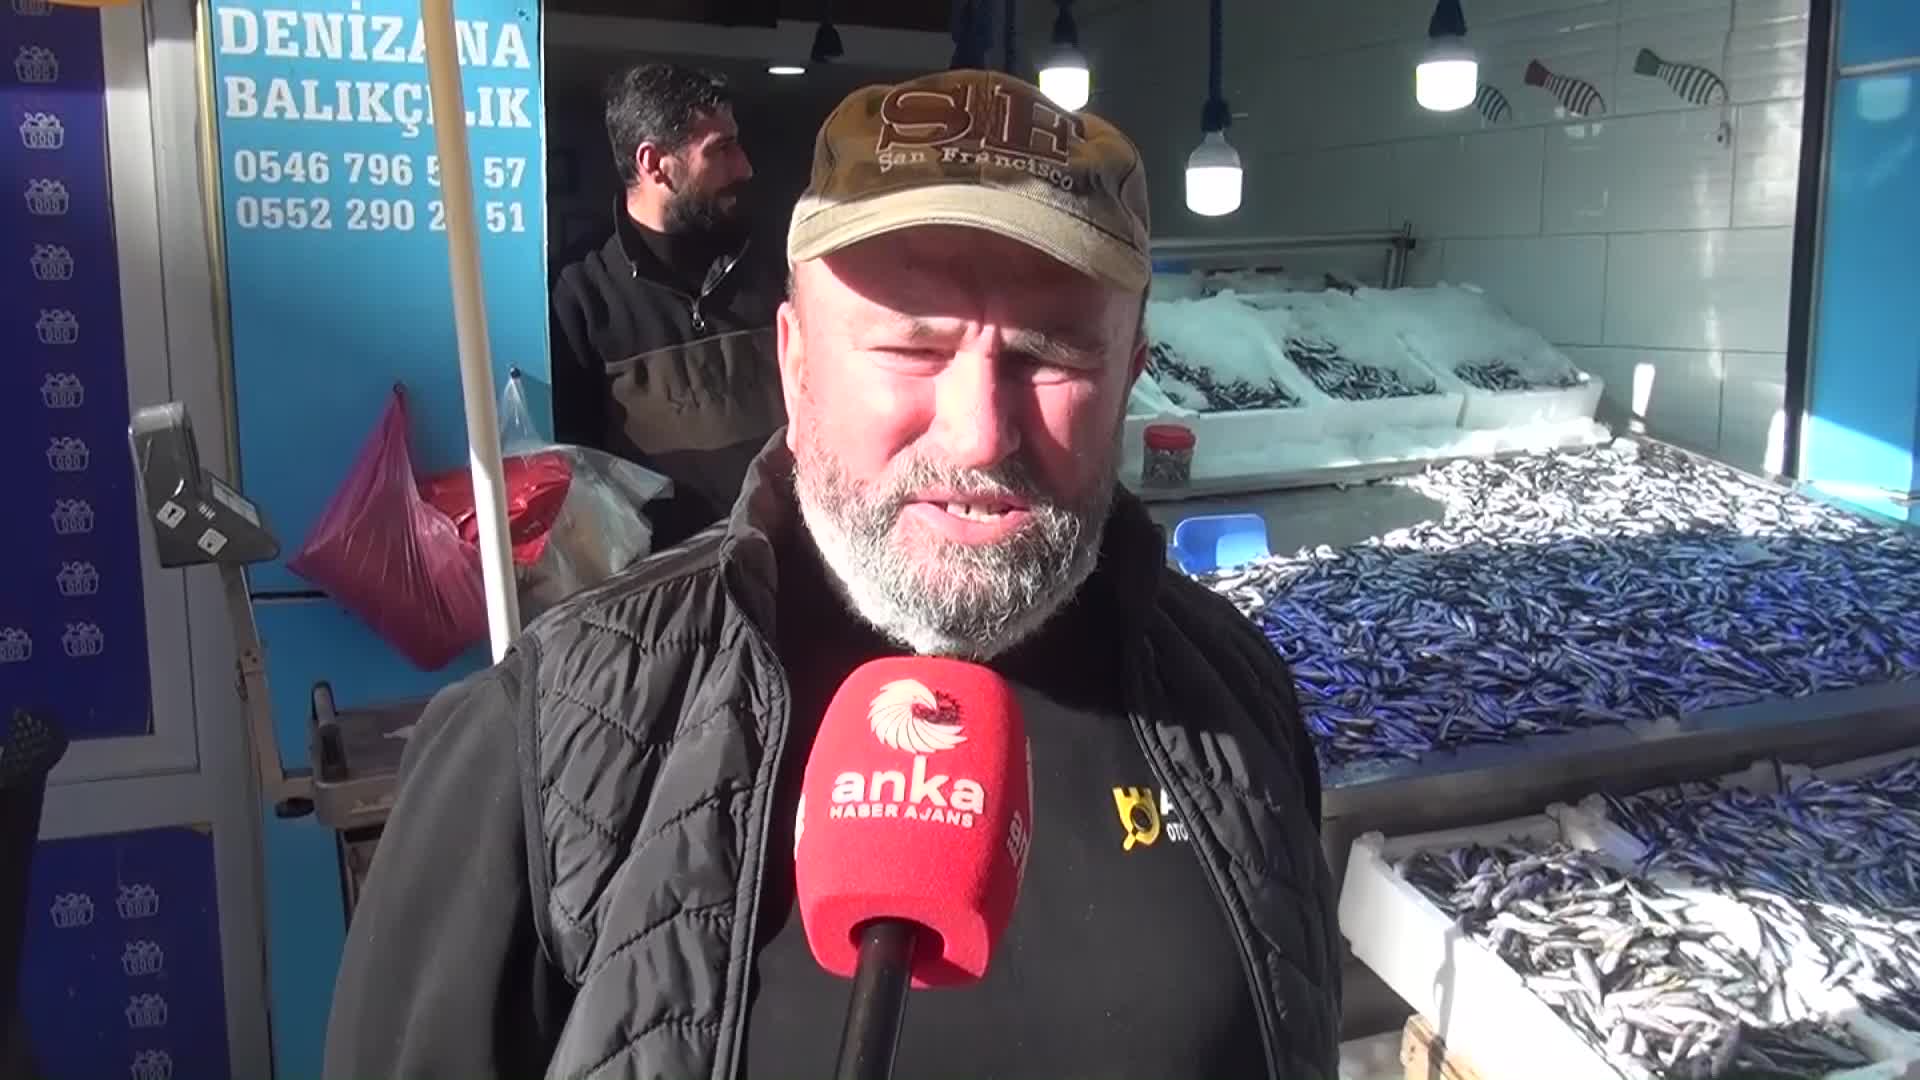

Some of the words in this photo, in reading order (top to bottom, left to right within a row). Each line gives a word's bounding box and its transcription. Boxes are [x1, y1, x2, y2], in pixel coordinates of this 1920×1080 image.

[234, 150, 330, 184] 0546
[344, 152, 413, 186] 796
[483, 156, 527, 189] 57
[879, 148, 927, 174] San
[942, 147, 1075, 192] Francisco
[236, 196, 332, 230] 0552
[346, 198, 415, 231] 290
[485, 202, 526, 233] 51
[831, 754, 985, 816] anka
[829, 803, 899, 821] HABER
